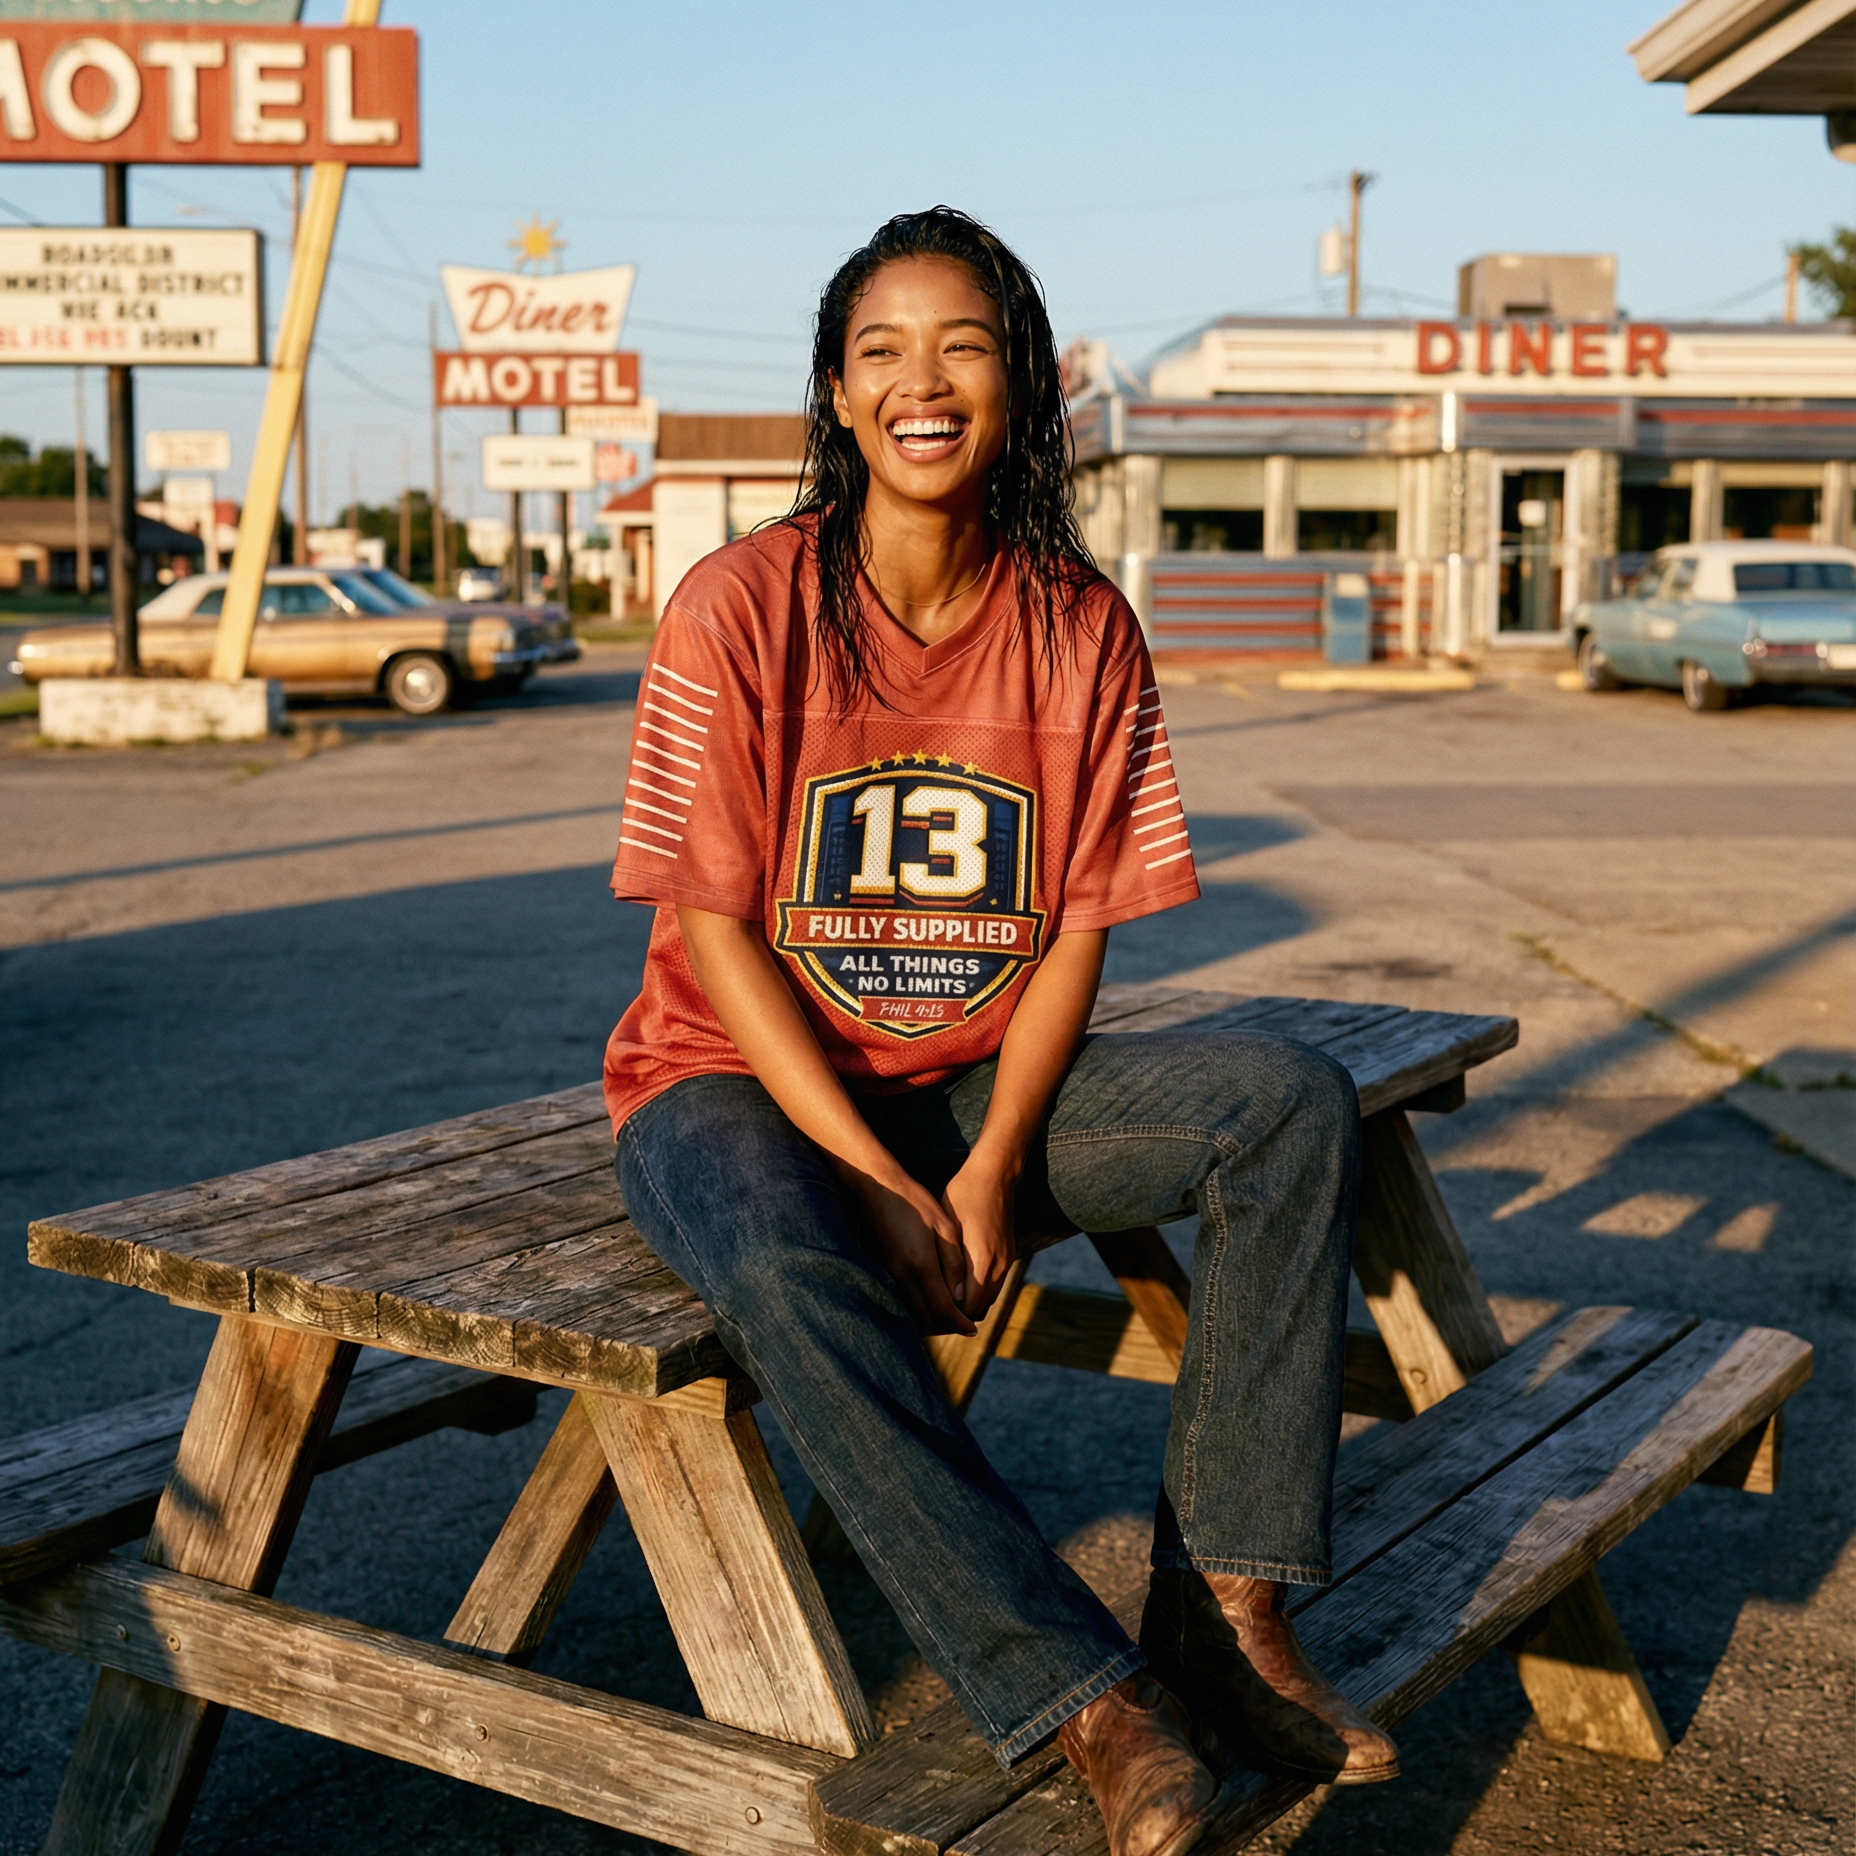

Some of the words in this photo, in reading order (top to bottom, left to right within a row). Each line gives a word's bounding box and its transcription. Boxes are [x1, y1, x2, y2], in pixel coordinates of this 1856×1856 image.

[0, 272, 123, 294] MMERCIAL
[138, 273, 244, 295] DISTRICT
[467, 282, 609, 334] Diner
[1417, 321, 1669, 377] DINER
[443, 356, 637, 402] MOTEL
[850, 784, 988, 897] 13
[808, 915, 888, 940] FULLY
[893, 917, 1018, 945] SUPPLIED
[839, 955, 884, 972] ALL
[890, 956, 980, 976] THINGS
[858, 976, 889, 992] NO
[895, 977, 967, 995] LIMITS
[879, 1002, 912, 1018] PHIL
